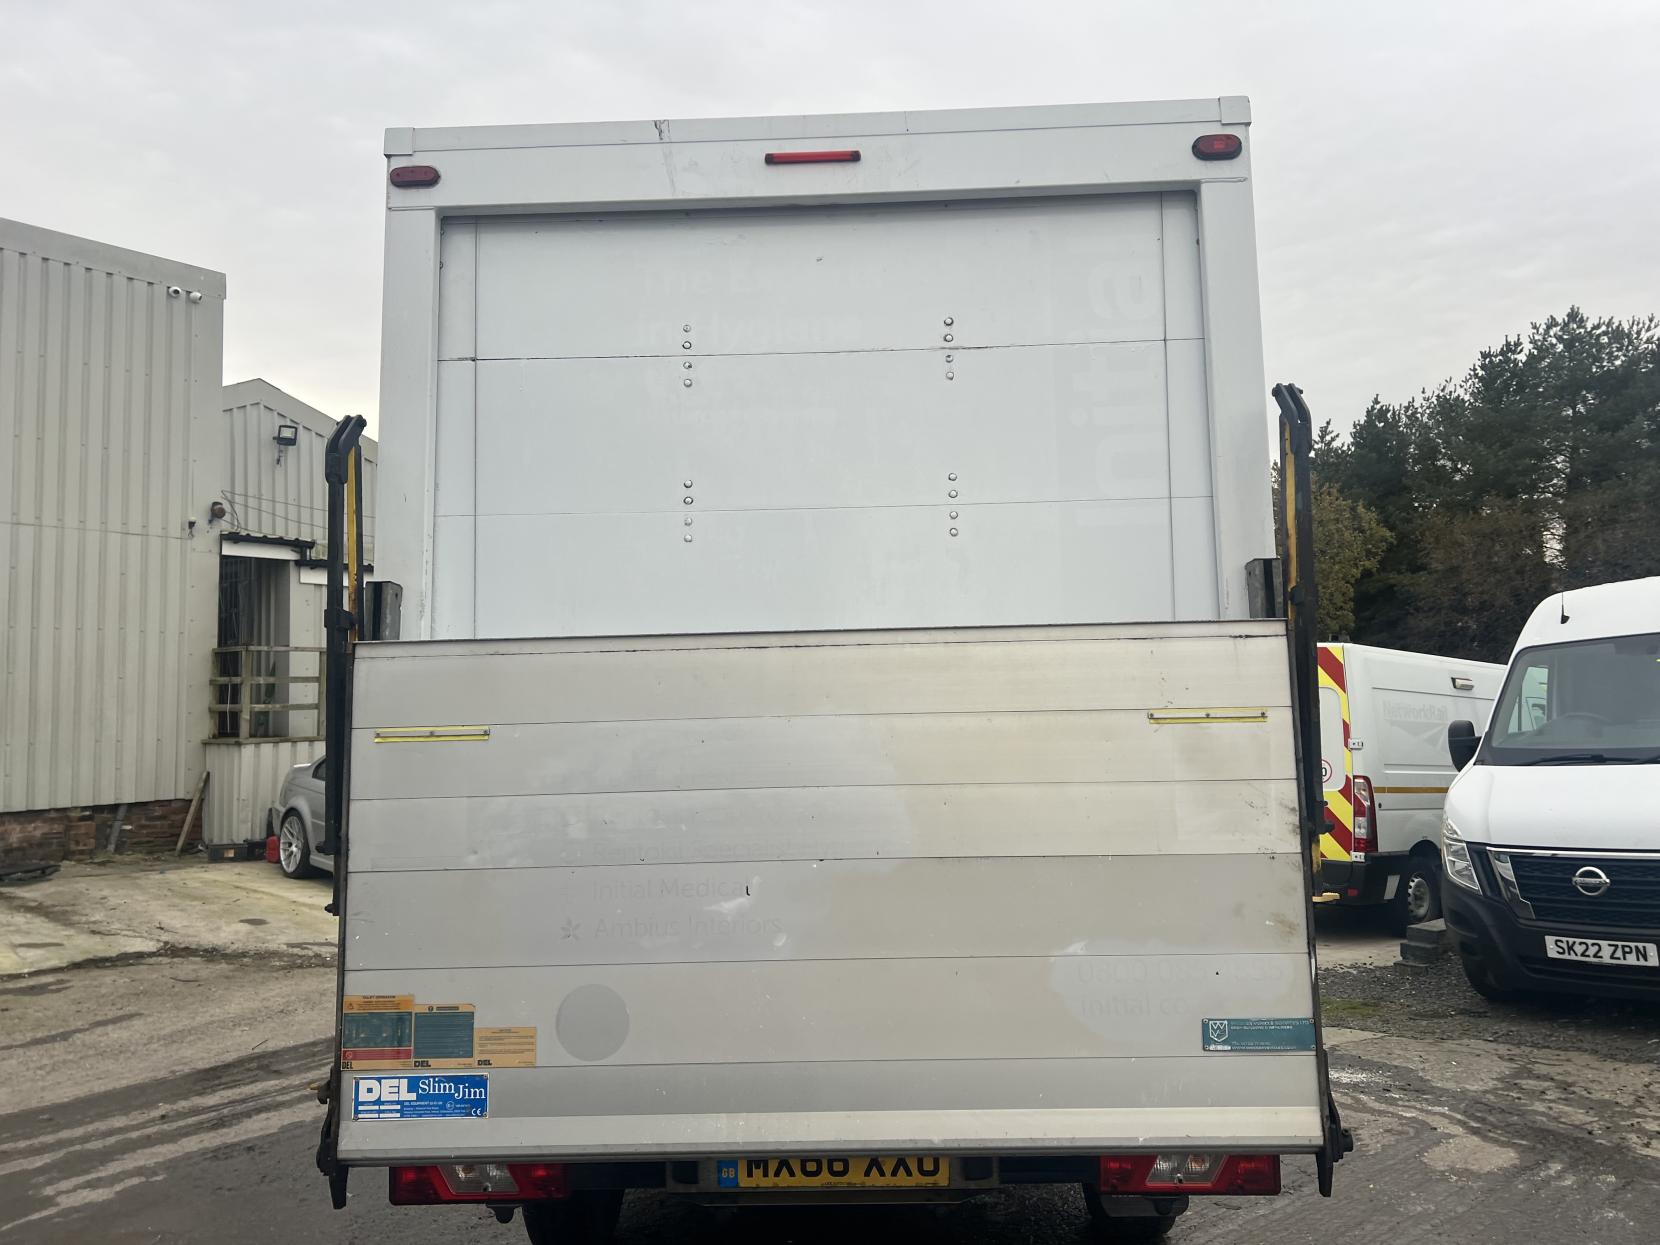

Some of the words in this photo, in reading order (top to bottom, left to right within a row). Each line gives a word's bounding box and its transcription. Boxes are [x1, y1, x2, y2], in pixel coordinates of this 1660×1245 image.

[594, 914, 681, 939] Ambius
[689, 912, 783, 936] Interiors
[1554, 939, 1603, 959] SK22
[1608, 943, 1648, 962] ZPN
[359, 1079, 416, 1101] DEL
[419, 1077, 455, 1094] Slim
[454, 1083, 486, 1099] Jim
[721, 1168, 735, 1179] GB
